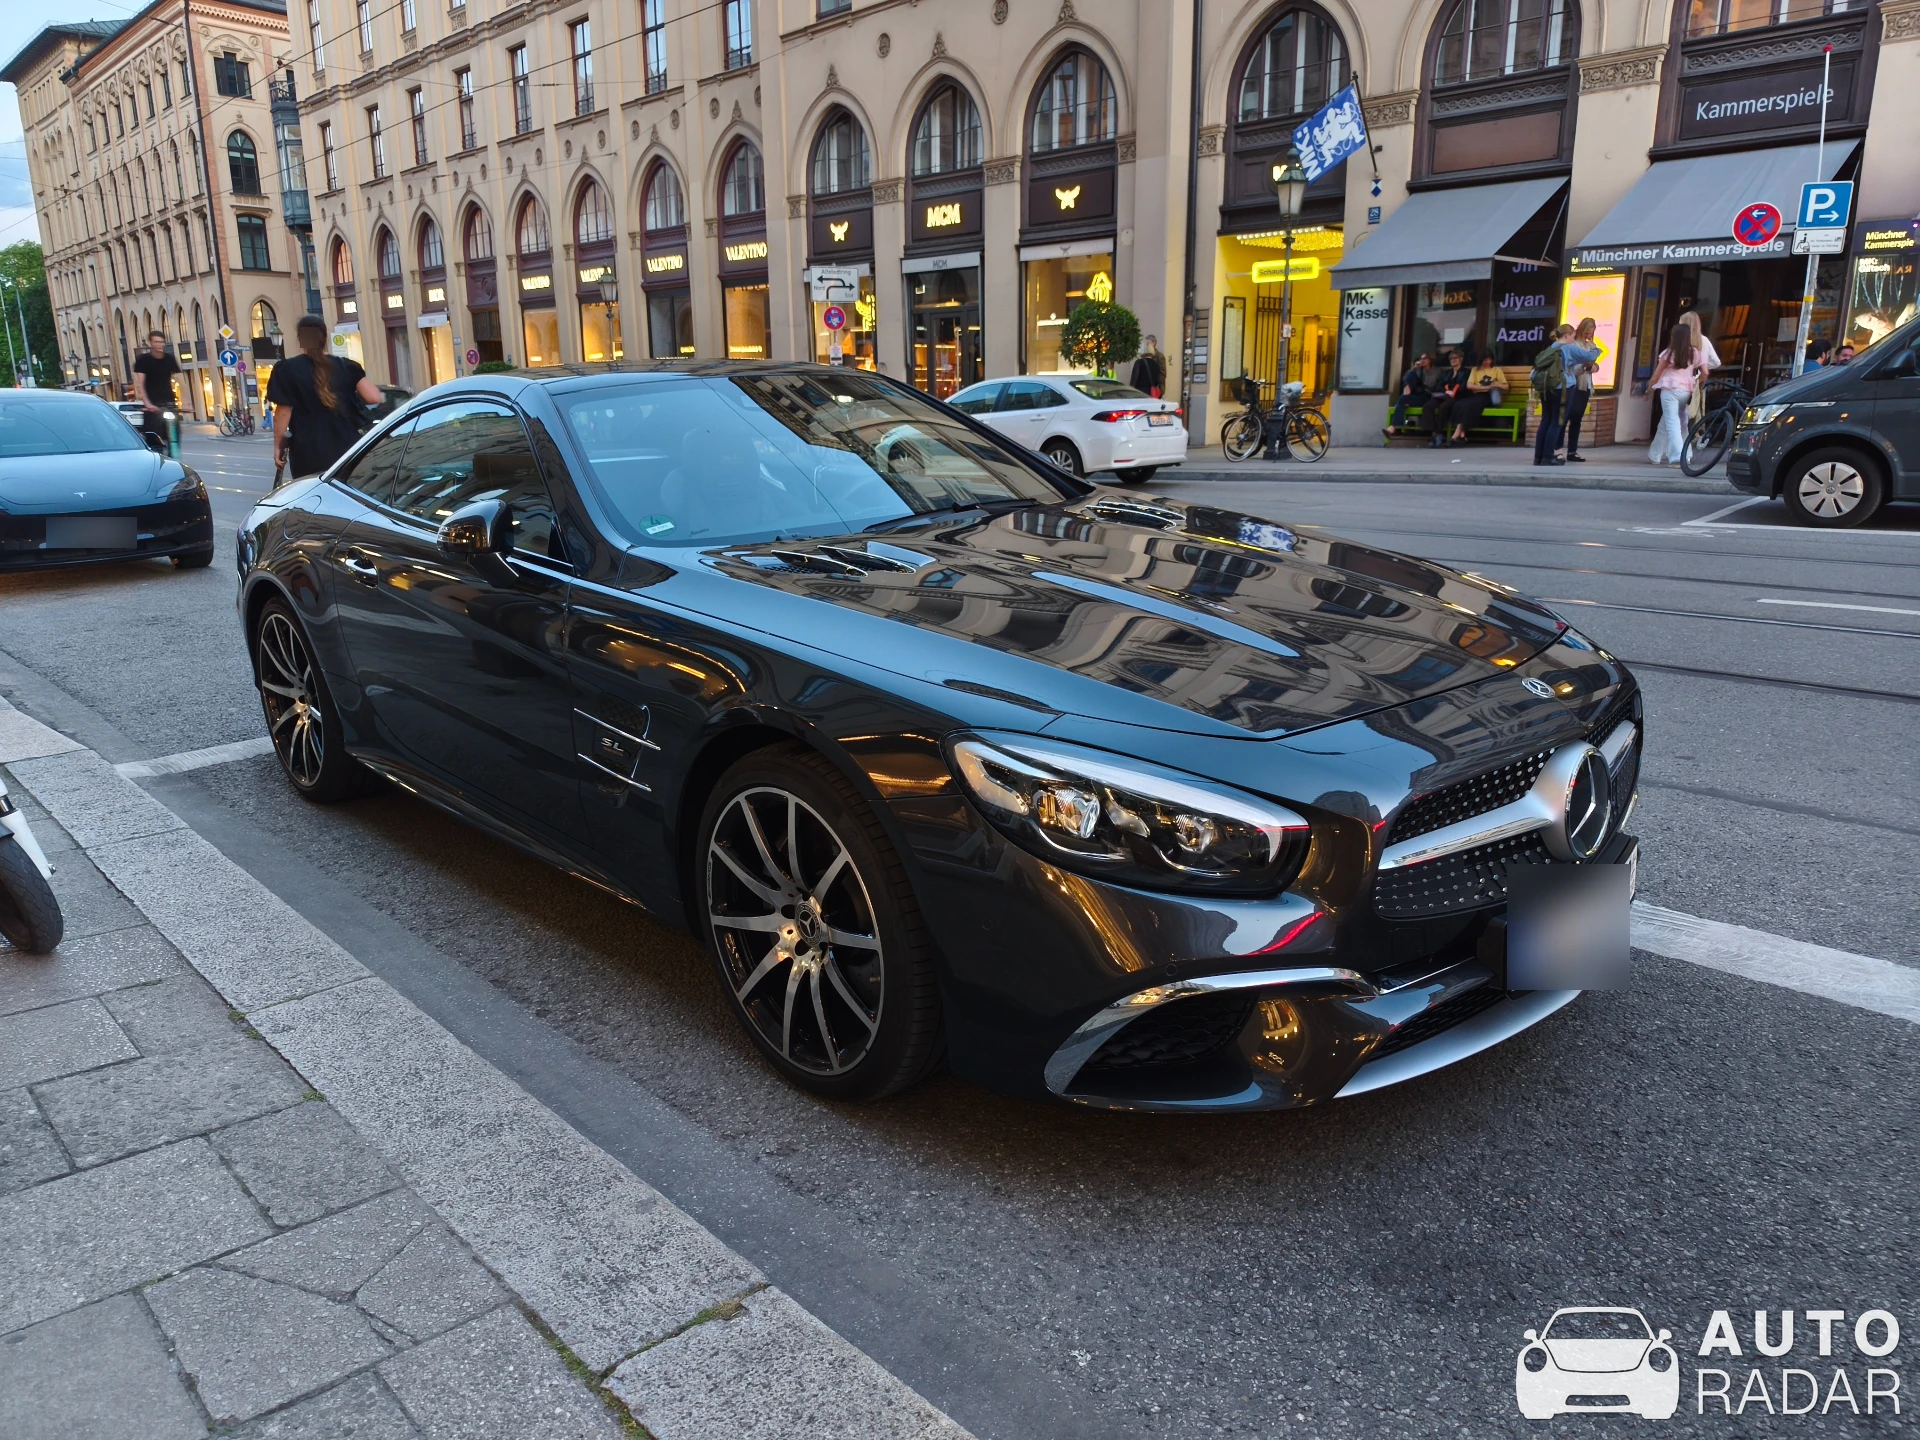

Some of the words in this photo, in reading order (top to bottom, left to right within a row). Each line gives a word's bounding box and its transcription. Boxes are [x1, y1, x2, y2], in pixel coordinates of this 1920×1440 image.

[1696, 83, 1834, 121] Kammerspiele
[1296, 126, 1322, 181] MK:
[1806, 188, 1836, 223] P
[926, 203, 961, 228] MCM
[1864, 230, 1908, 241] Münchner
[1864, 237, 1915, 250] Kammerspie
[725, 242, 767, 261] VALENTINO
[1582, 247, 1660, 263] Münchner
[646, 255, 682, 272] VALENTINO
[932, 259, 948, 270] MCM
[1258, 265, 1313, 277] Schauselhaus
[1346, 291, 1374, 306] MK:
[1499, 293, 1545, 312] Jiyan
[1345, 306, 1390, 320] Kasse
[1496, 326, 1545, 342] Azadî
[600, 737, 625, 752] SL
